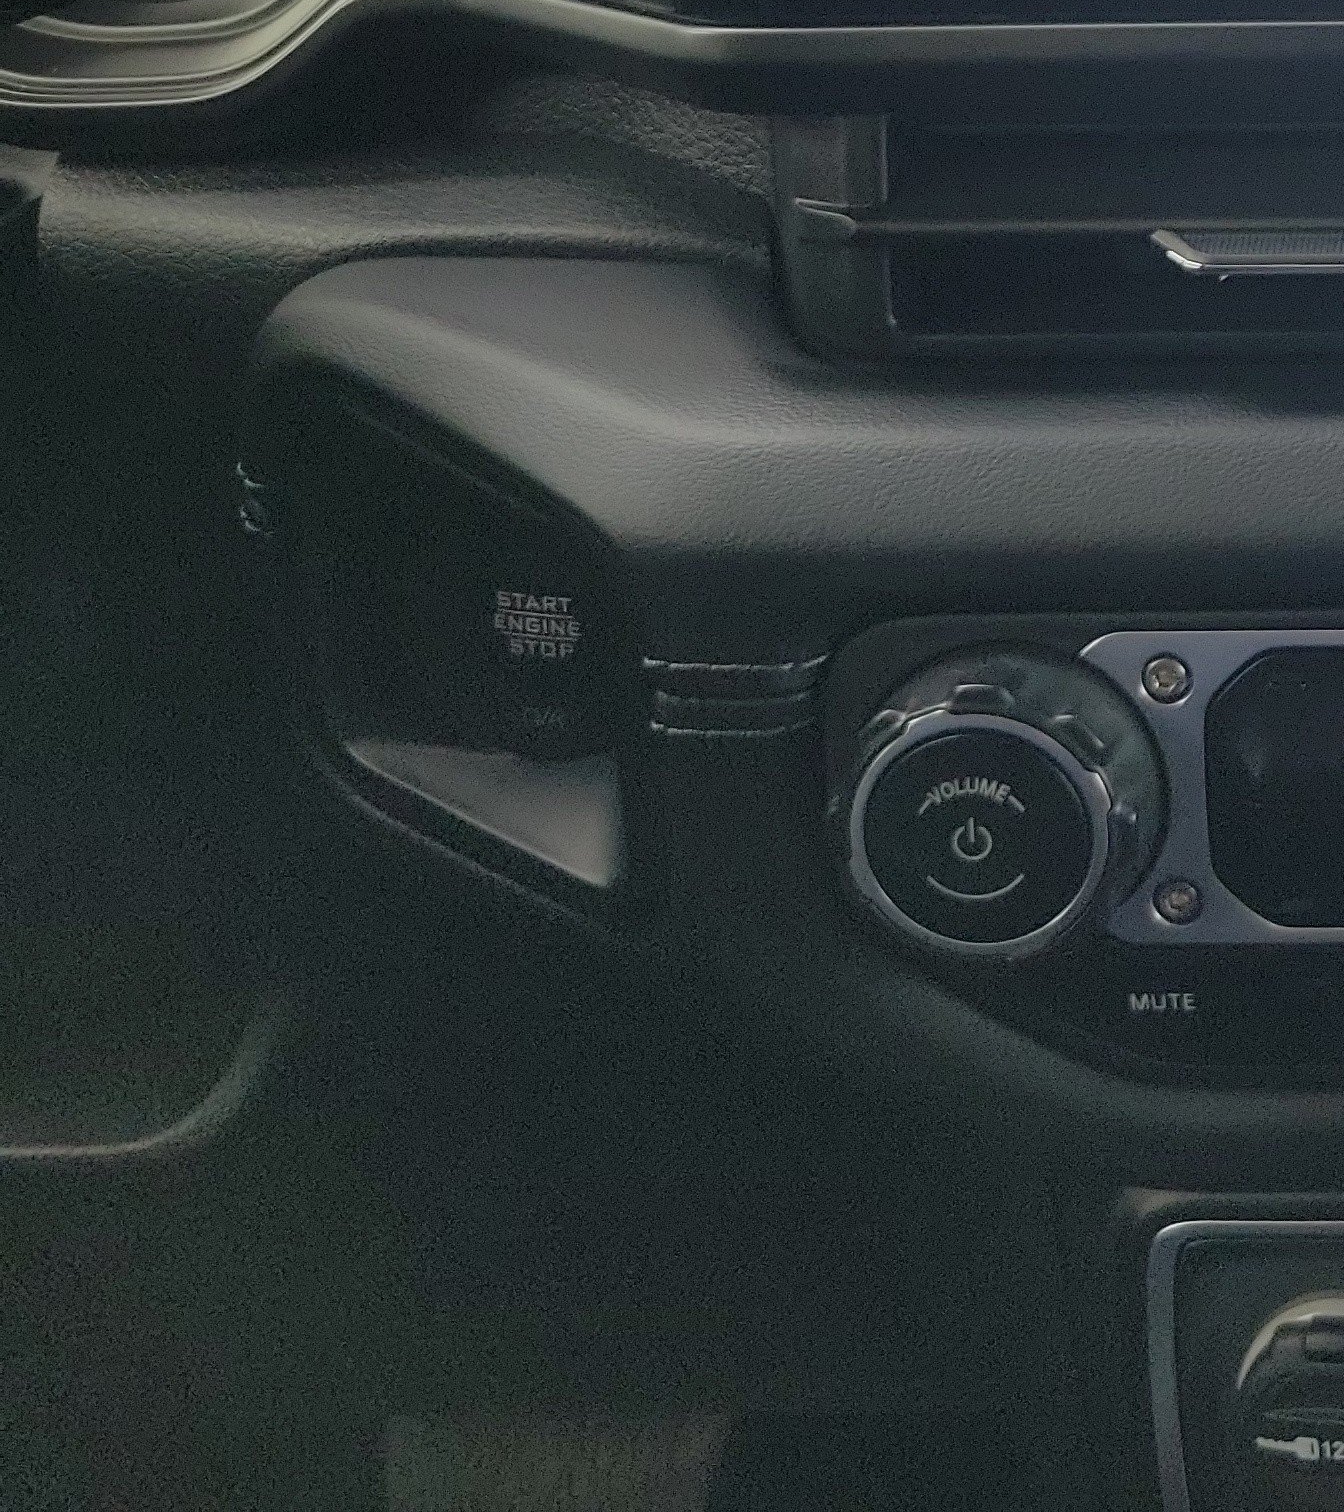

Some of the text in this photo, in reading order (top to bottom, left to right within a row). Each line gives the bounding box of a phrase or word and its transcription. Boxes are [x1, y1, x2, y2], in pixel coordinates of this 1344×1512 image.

[498, 592, 572, 612] START
[495, 614, 583, 637] ENGINE
[510, 641, 574, 658] STOP
[927, 775, 1012, 803] VOLUME
[1129, 992, 1197, 1012] MUTE
